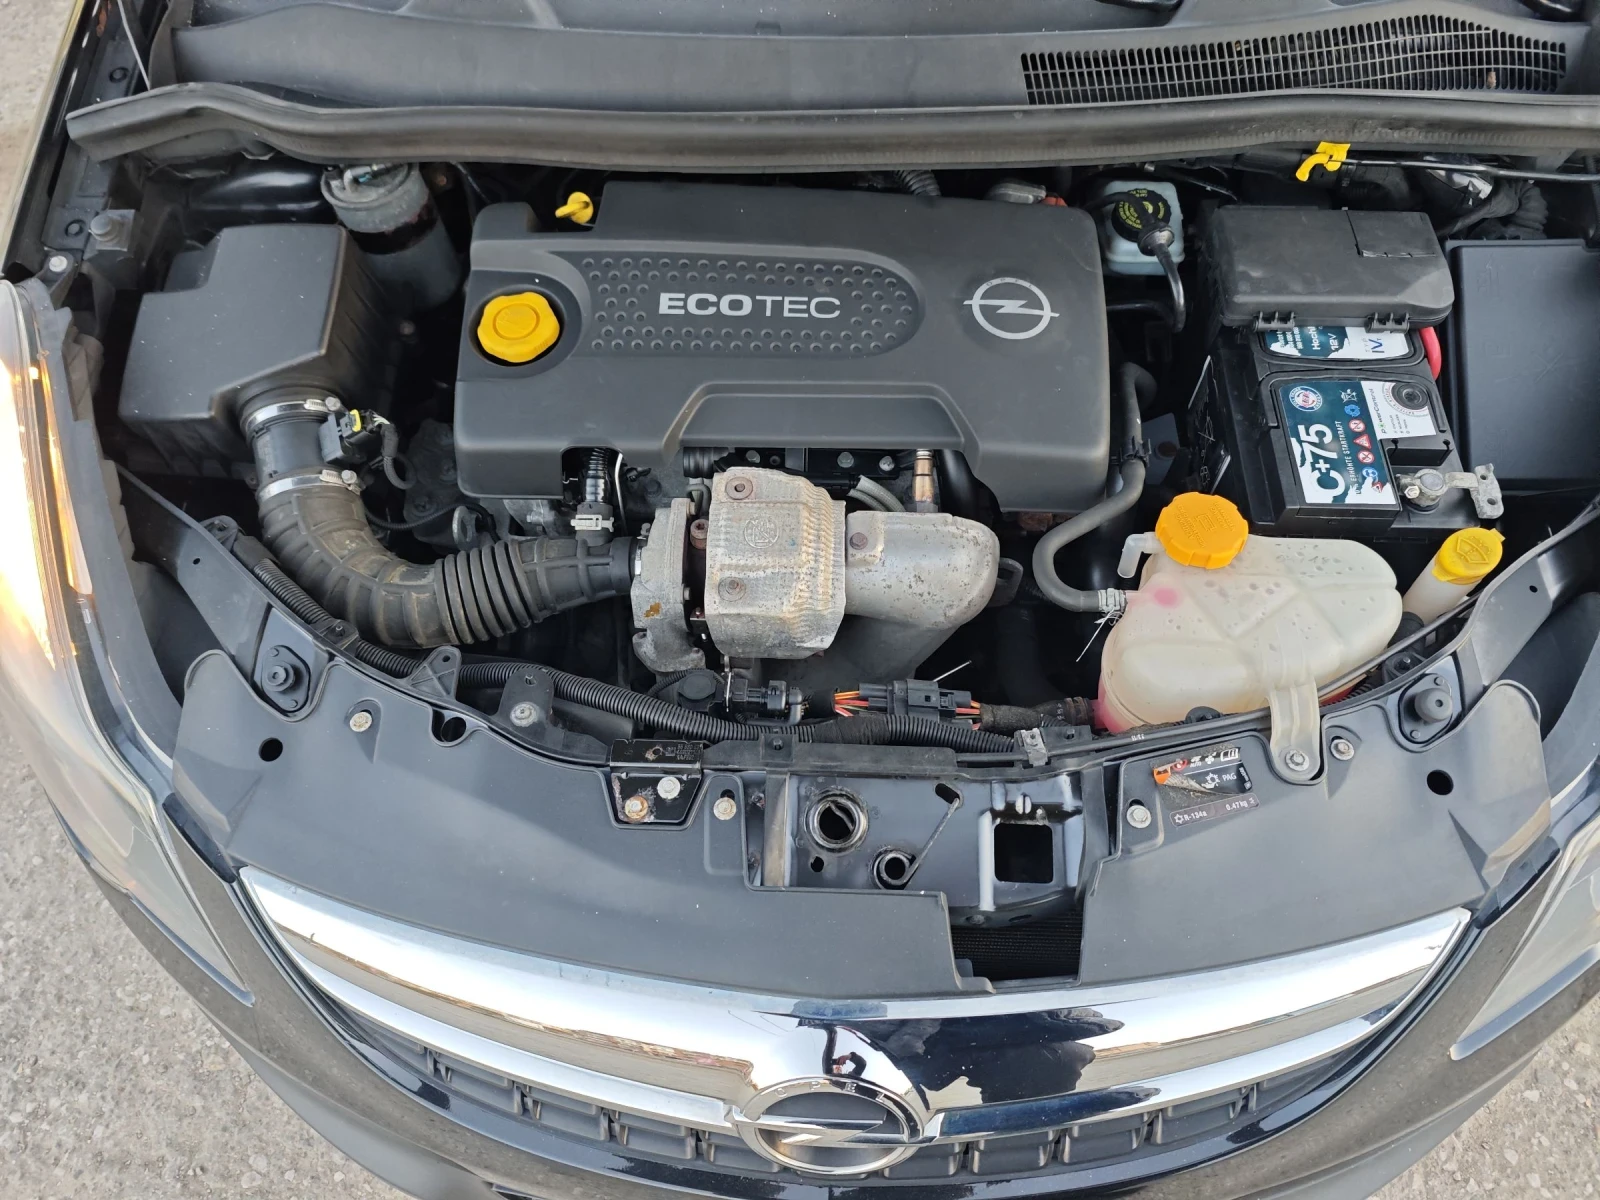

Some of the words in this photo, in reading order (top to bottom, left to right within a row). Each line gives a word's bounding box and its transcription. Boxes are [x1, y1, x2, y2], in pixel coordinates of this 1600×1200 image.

[986, 278, 1033, 289] OPEL
[658, 292, 841, 319] ECOTEC
[1327, 332, 1340, 351] 12V
[1335, 421, 1351, 455] STARTKRAFT
[1298, 423, 1346, 497] C+75
[1222, 771, 1237, 782] PAG
[1183, 809, 1208, 821] R-134a
[777, 1081, 886, 1102] OPEL
